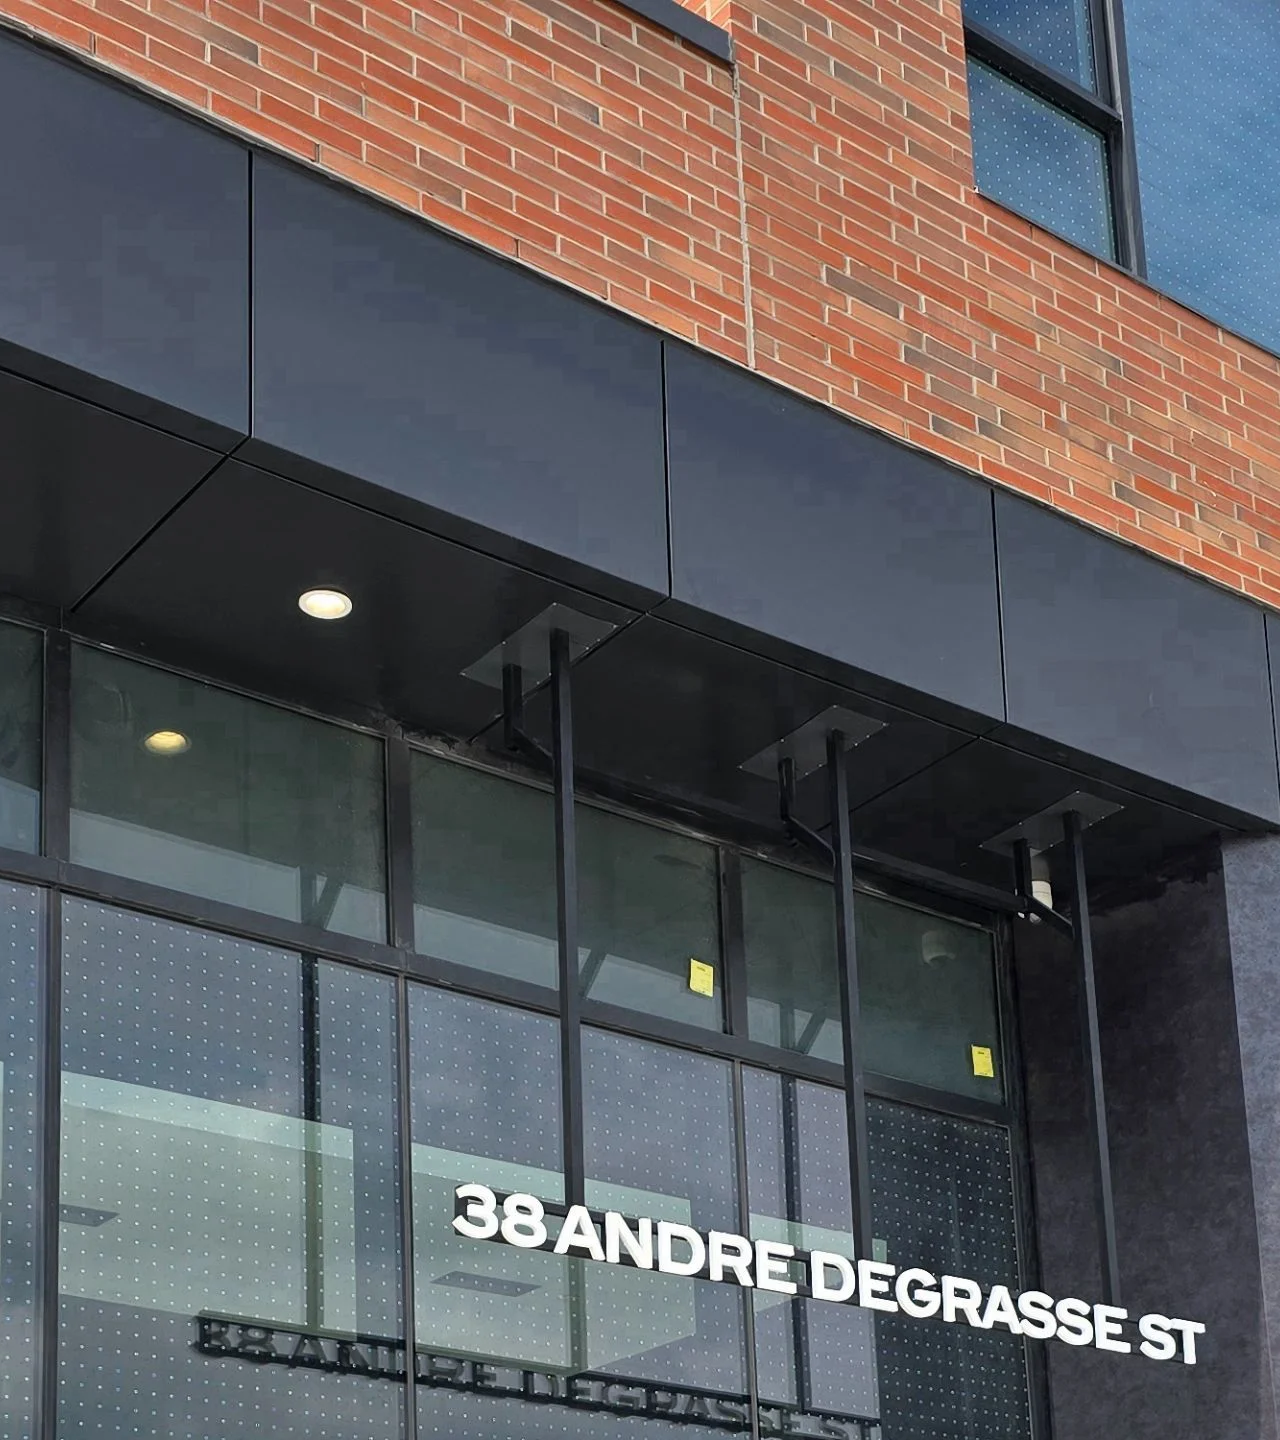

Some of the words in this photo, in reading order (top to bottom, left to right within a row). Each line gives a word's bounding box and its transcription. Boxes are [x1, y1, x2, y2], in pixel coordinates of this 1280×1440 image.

[451, 1184, 548, 1249] 38
[552, 1204, 797, 1295] ANDRE
[811, 1251, 1131, 1352] DEGRASSE
[1137, 1313, 1206, 1365] ST
